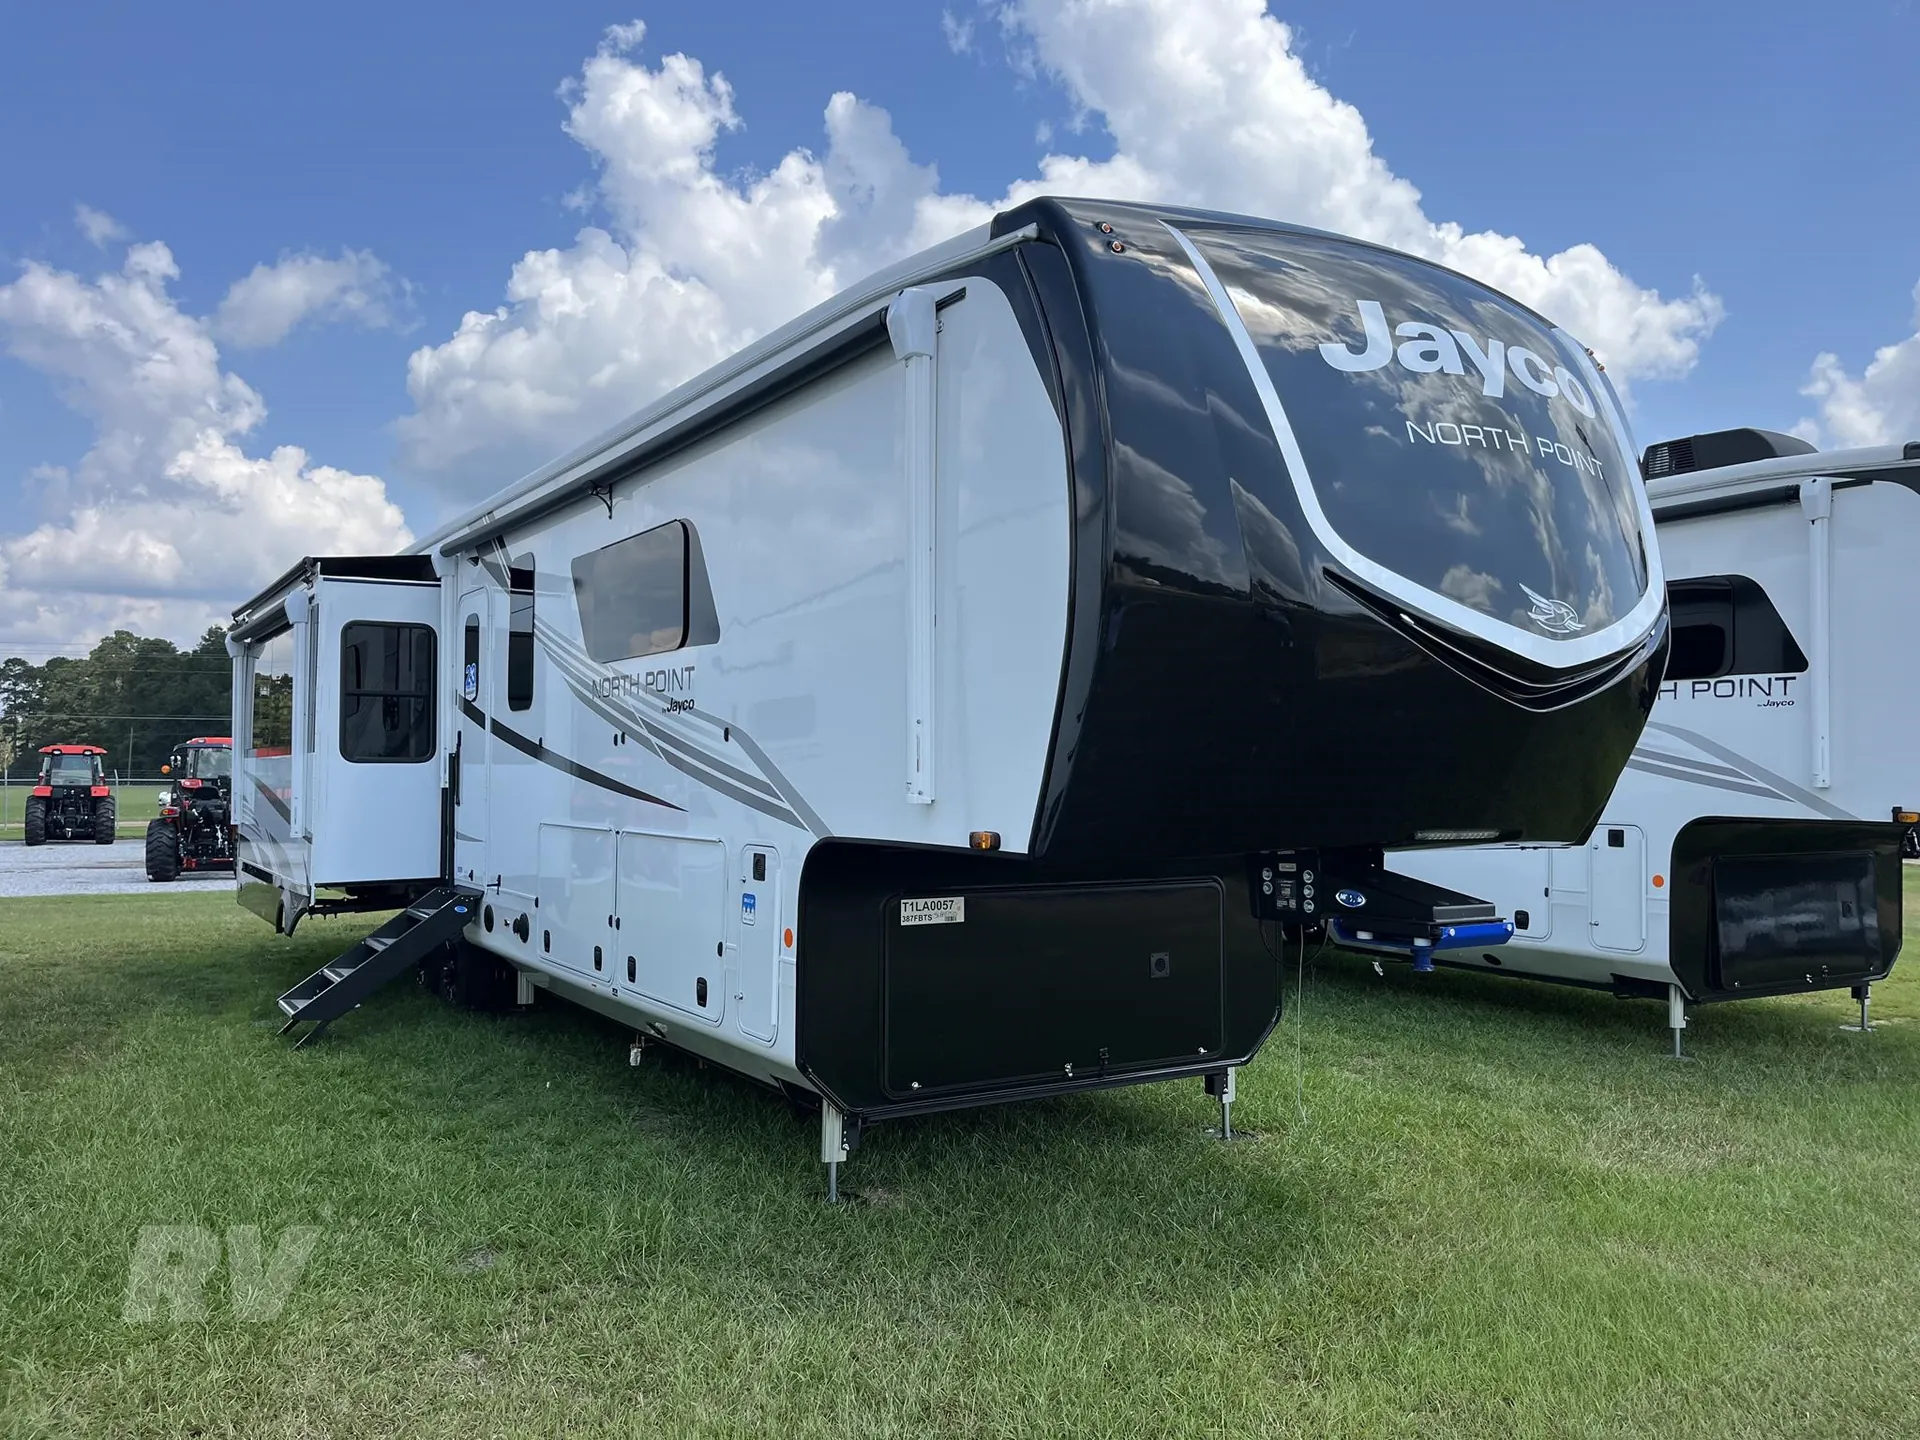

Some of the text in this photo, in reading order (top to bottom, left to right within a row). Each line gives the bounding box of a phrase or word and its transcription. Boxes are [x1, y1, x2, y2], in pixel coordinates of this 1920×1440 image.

[1318, 299, 1596, 419] Jayco
[1405, 420, 1604, 480] NORTH POINT
[591, 665, 695, 700] NORTH POINT
[1691, 676, 1797, 700] POINT
[667, 697, 695, 715] Jayco
[1763, 699, 1795, 708] Jayco
[902, 900, 954, 912] T1LA0057
